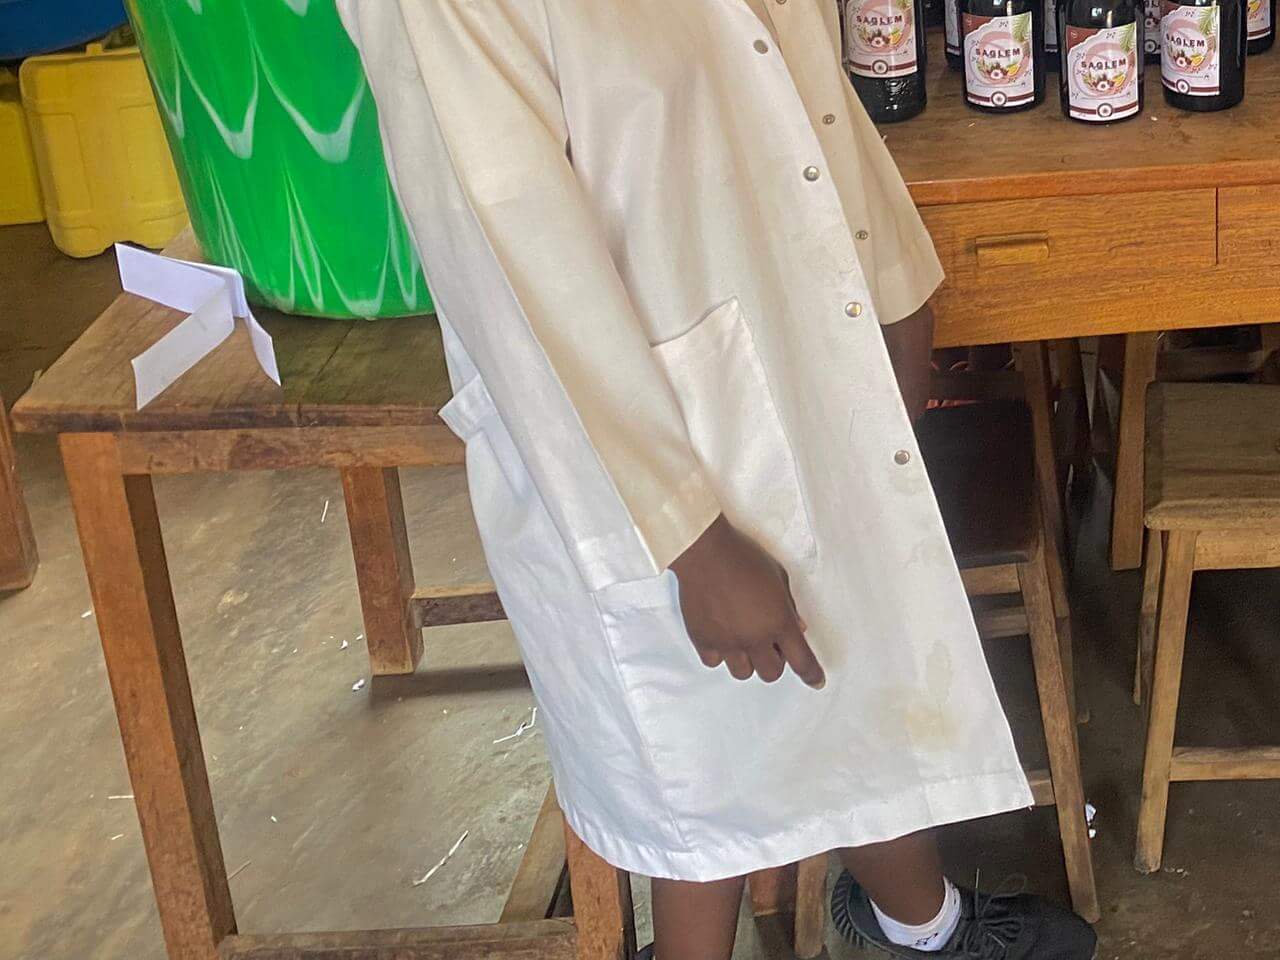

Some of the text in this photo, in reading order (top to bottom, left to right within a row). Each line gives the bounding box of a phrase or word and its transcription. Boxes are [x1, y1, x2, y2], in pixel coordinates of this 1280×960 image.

[856, 15, 902, 26] SAGLEM
[976, 47, 1020, 58] SAGLEM
[1081, 58, 1126, 70] SAGLEM
